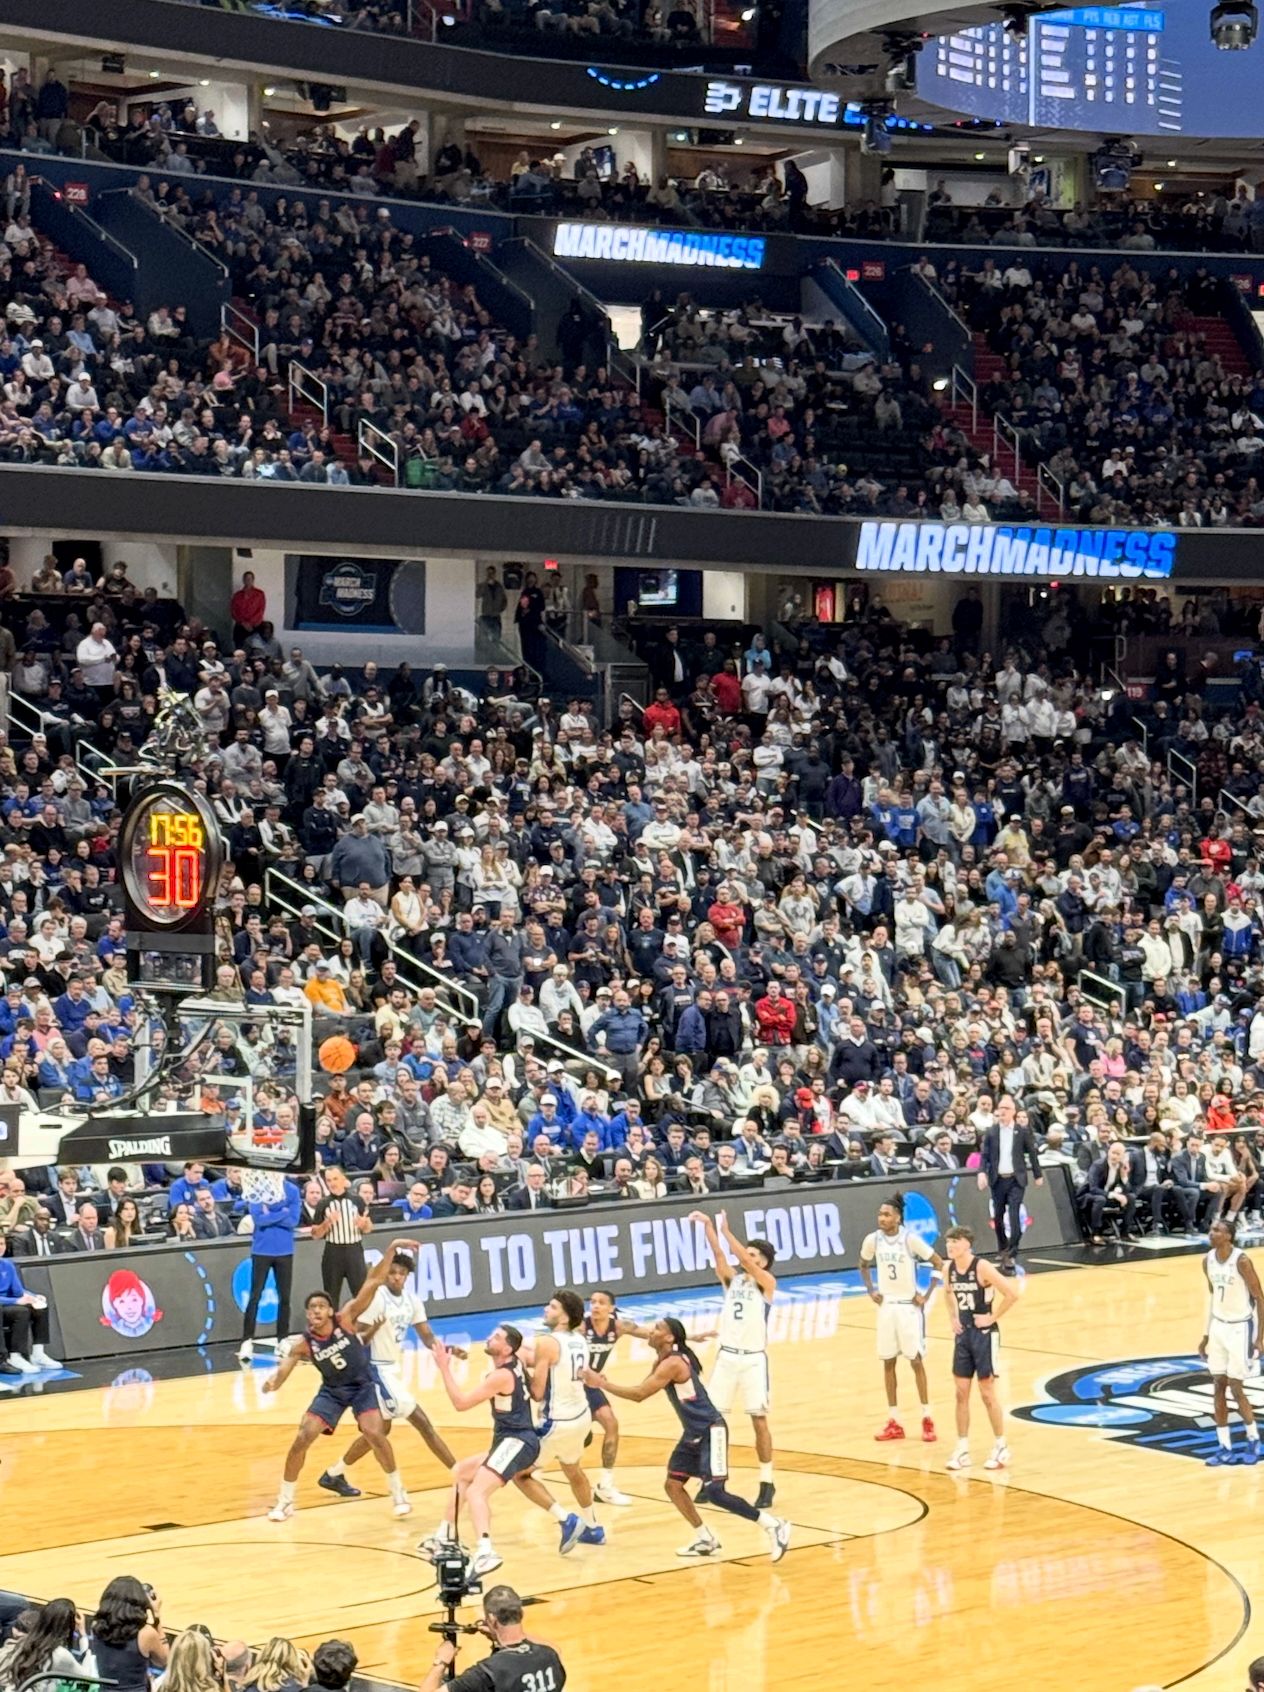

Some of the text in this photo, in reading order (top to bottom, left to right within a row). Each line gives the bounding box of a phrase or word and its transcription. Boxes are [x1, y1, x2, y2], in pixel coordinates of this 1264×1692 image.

[748, 86, 840, 123] ELITE
[150, 814, 203, 848] 17:56
[146, 848, 199, 908] 30
[108, 1135, 172, 1160] SPALDING
[480, 1232, 538, 1294] TO
[544, 1224, 625, 1288] THE
[887, 1264, 898, 1281] 3
[1217, 1285, 1225, 1303] 7
[733, 1301, 744, 1321] 2
[313, 1336, 351, 1362] UCONN
[330, 1352, 348, 1370] 5
[591, 1353, 600, 1369] 1
[520, 1666, 556, 1692] 311
